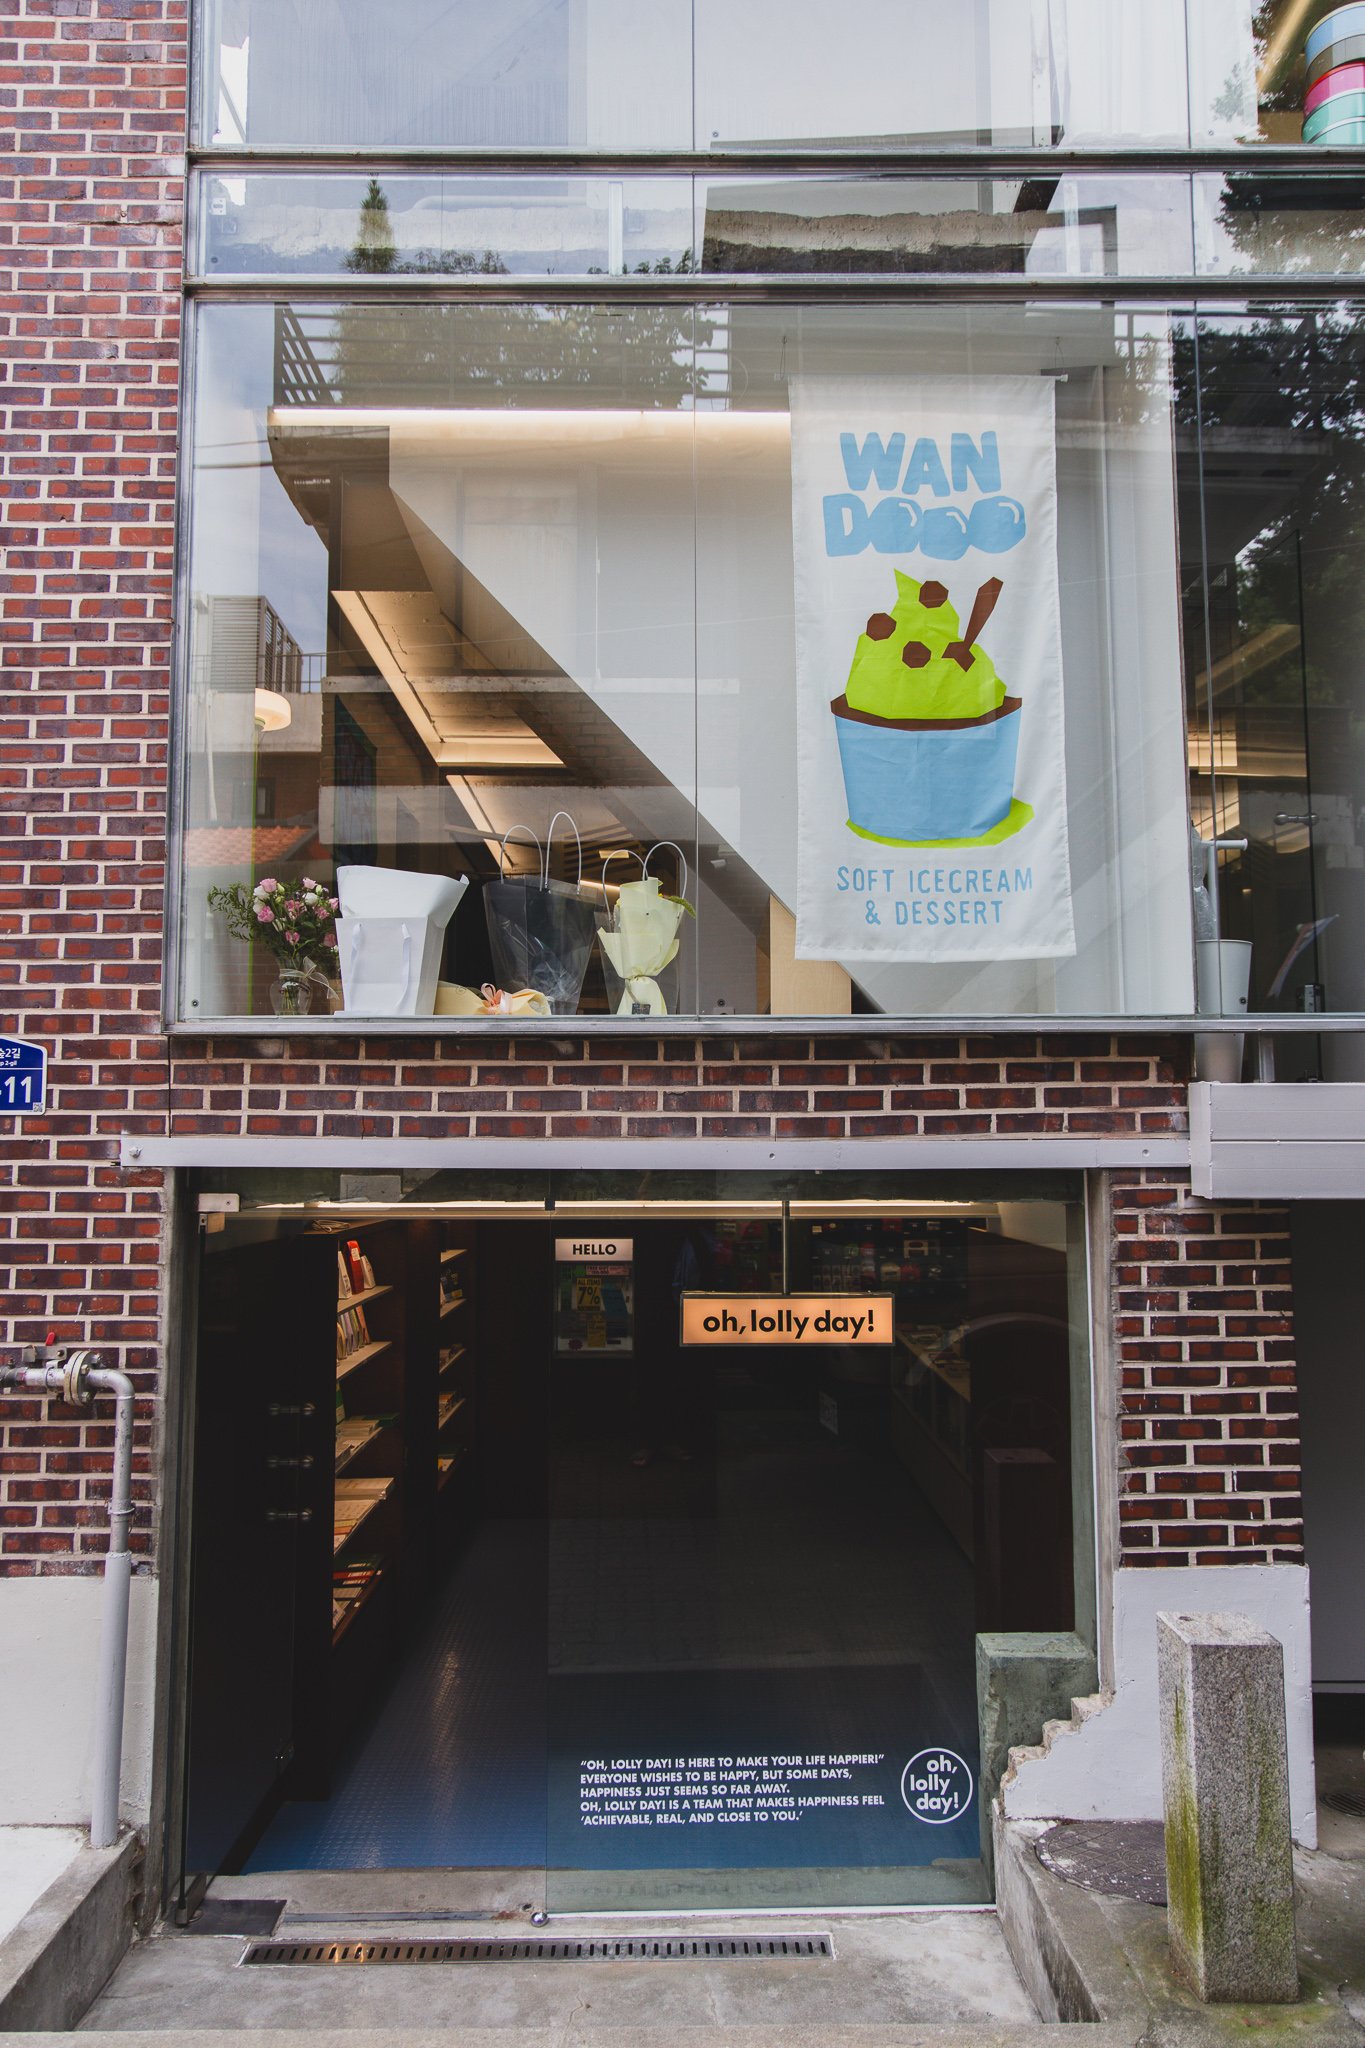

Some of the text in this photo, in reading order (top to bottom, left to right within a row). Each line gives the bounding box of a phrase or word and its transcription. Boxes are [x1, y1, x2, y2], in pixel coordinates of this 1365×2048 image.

[838, 430, 1002, 497] WAN
[836, 864, 1034, 895] SOFT ICECREAM
[864, 898, 1004, 927] & DESSERT
[0, 1076, 32, 1104] 11
[572, 1243, 617, 1256] HELLO
[578, 1286, 601, 1305] 7%
[702, 1308, 875, 1340] oh, lolly day!
[611, 1759, 643, 1770] LOLLY
[646, 1758, 672, 1769] DAY!
[675, 1758, 686, 1768] IS
[688, 1757, 716, 1768] HERE
[718, 1757, 734, 1767] TO
[736, 1756, 769, 1767] MAKE
[771, 1756, 803, 1767] YOUR
[805, 1755, 826, 1766] LIFE
[926, 1754, 958, 1774] oh,
[580, 1768, 853, 1784] EVERYONE WISHES TO BE HAPPY, BUT SOME DAYS,
[909, 1773, 951, 1796] lolly
[580, 1783, 791, 1798] HAPPINESS JUST SEEMS SO FAR AWAY.
[580, 1795, 885, 1813] OH, LOLLY DAY! IS A TEAM THAT MAKES HAPPINESS FEEL
[915, 1791, 960, 1815] day!
[656, 1814, 686, 1825] REAL,
[688, 1813, 715, 1823] AND
[717, 1812, 751, 1823] CLOSE
[753, 1811, 769, 1822] TO
